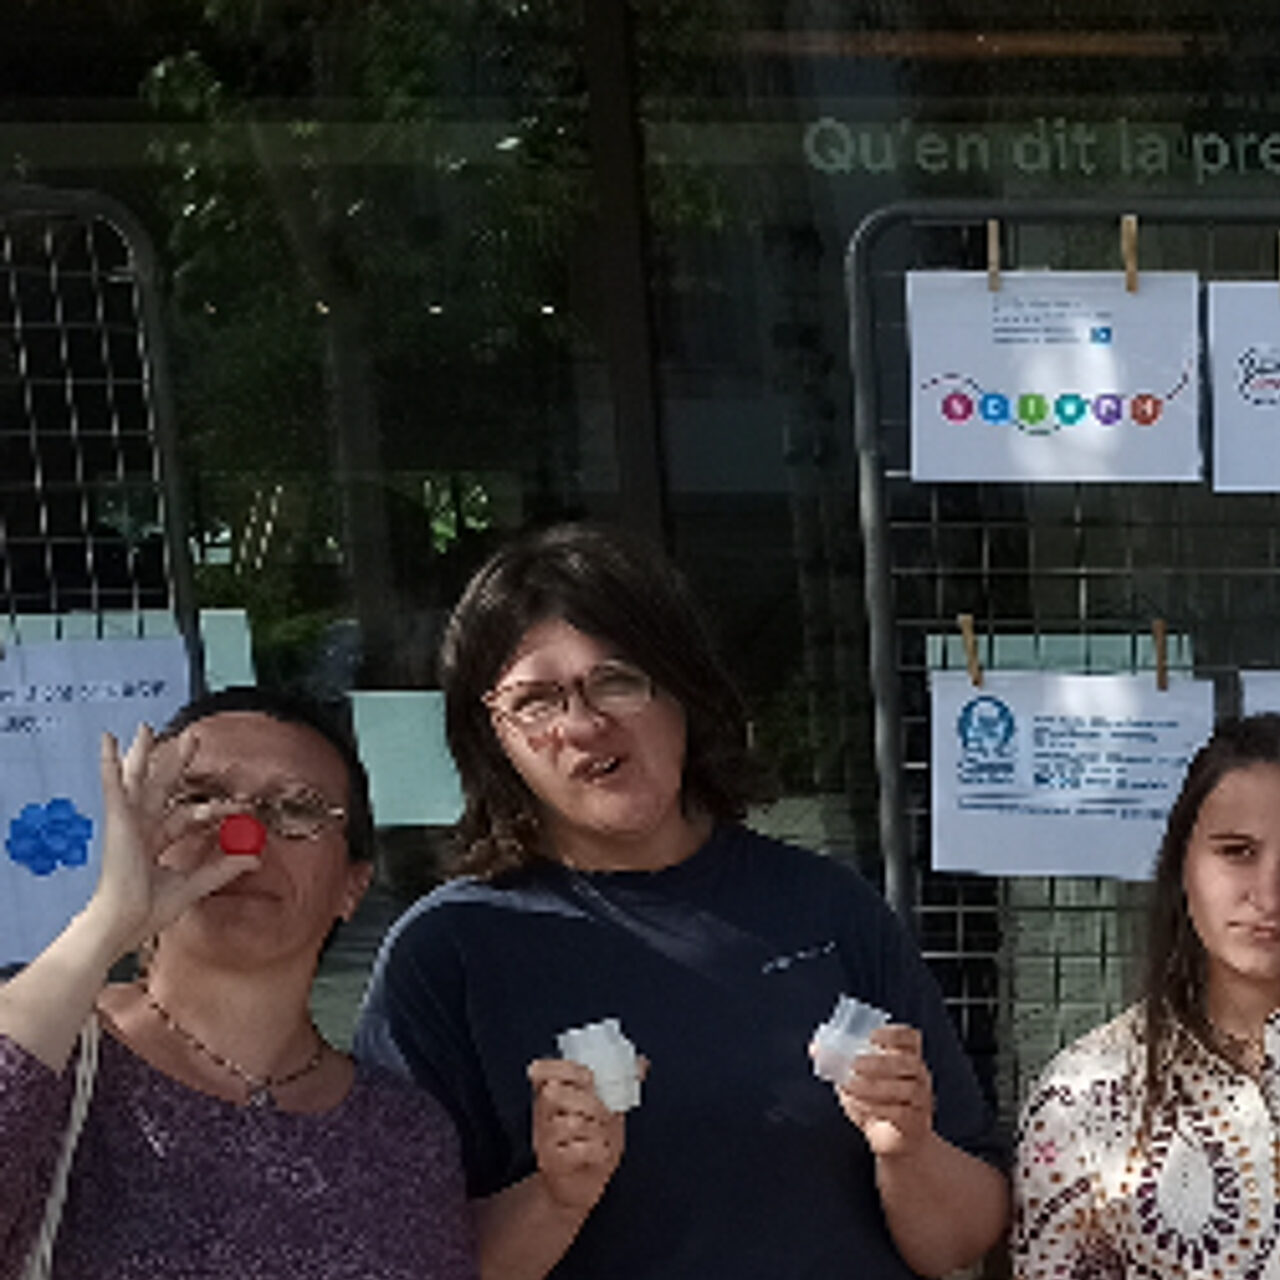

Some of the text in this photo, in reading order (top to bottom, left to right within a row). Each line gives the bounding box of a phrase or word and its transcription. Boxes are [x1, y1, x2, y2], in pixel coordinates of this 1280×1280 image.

[803, 118, 989, 175] Qu'en
[1012, 118, 1096, 174] dit
[1120, 117, 1169, 173] la
